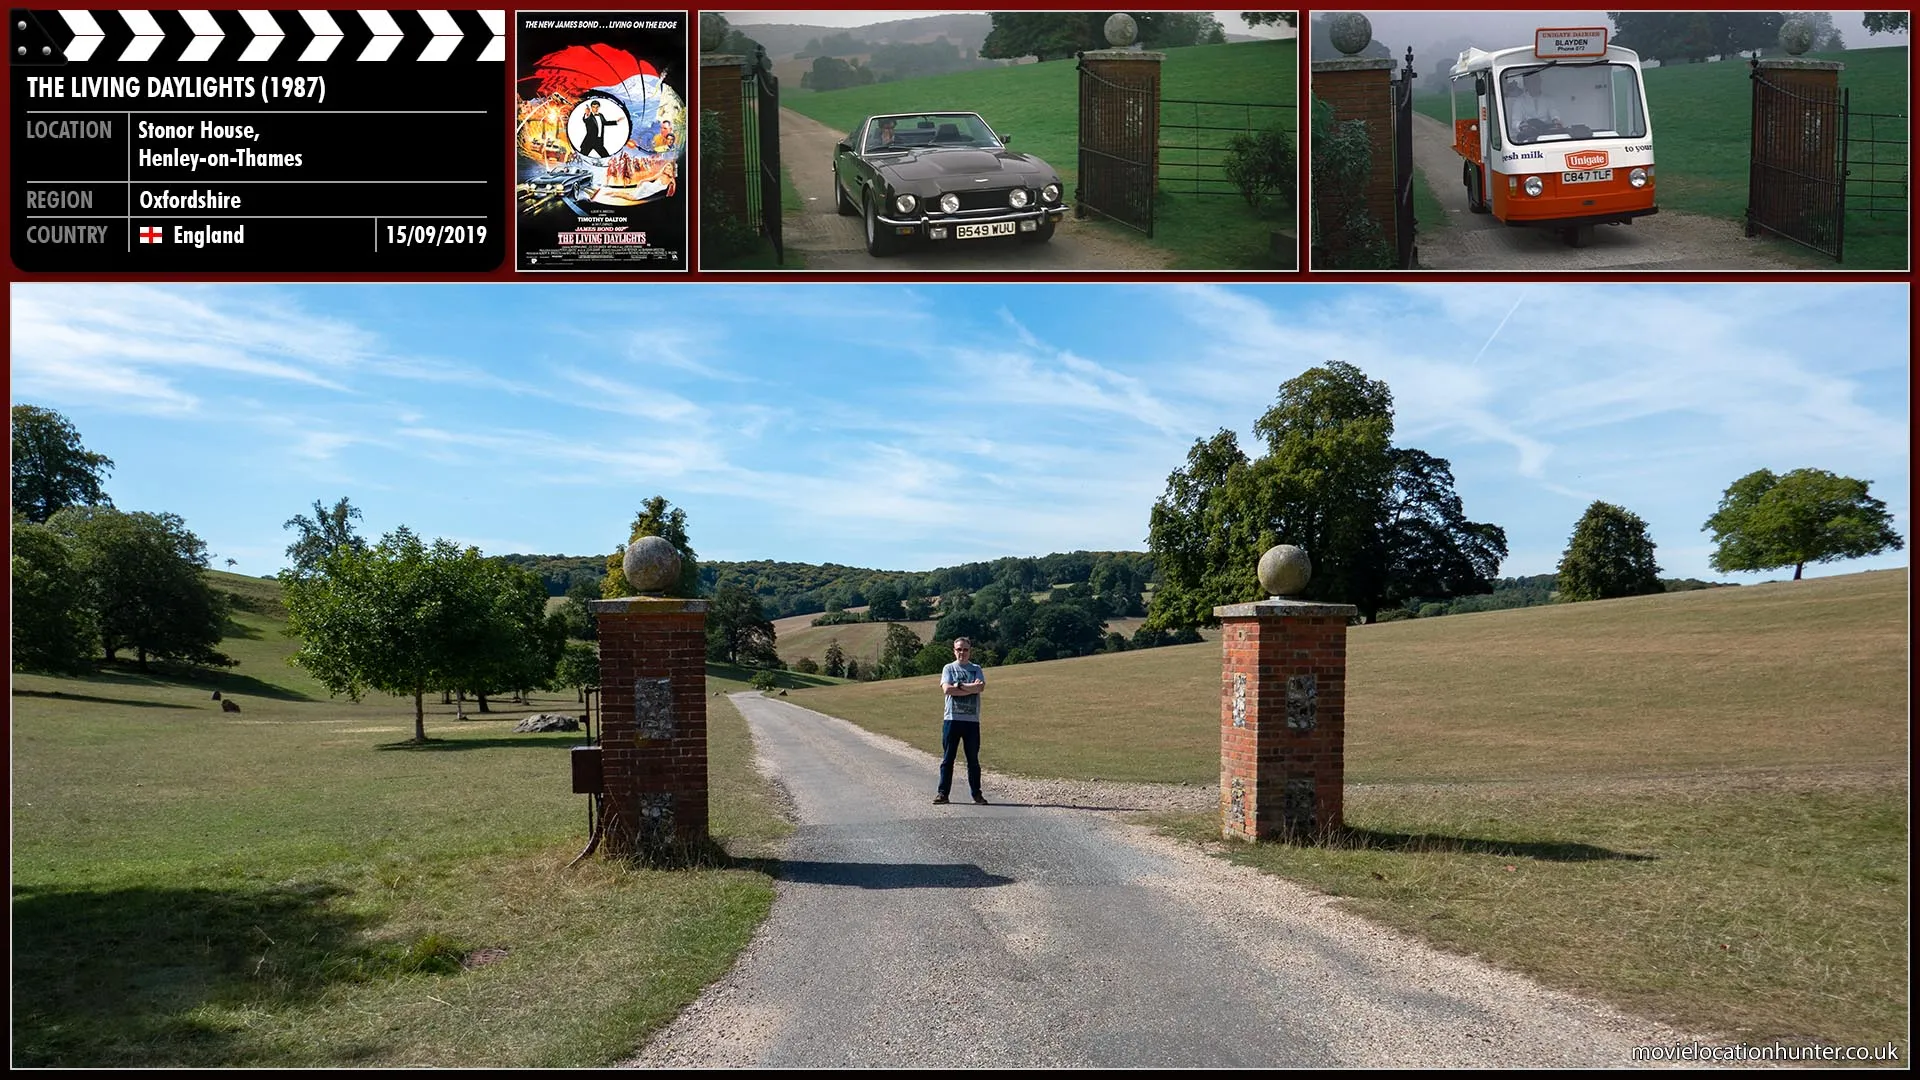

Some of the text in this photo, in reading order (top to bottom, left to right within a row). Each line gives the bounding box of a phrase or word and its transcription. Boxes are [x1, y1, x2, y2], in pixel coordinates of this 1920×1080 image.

[525, 20, 538, 29] THE
[538, 20, 555, 29] NEW
[555, 20, 578, 29] JAMES
[578, 20, 599, 29] BOND
[609, 20, 632, 29] LIVING
[633, 20, 645, 29] ON
[645, 20, 658, 29] THE
[658, 20, 677, 29] EDGE
[1521, 149, 1544, 160] milk
[1624, 144, 1652, 154] to your
[1570, 154, 1605, 166] Unigate
[1563, 170, 1612, 182] C847 TLF
[958, 222, 1014, 238] B549 WUU
[558, 232, 647, 245] THE LIVING DAYLIGHTS
